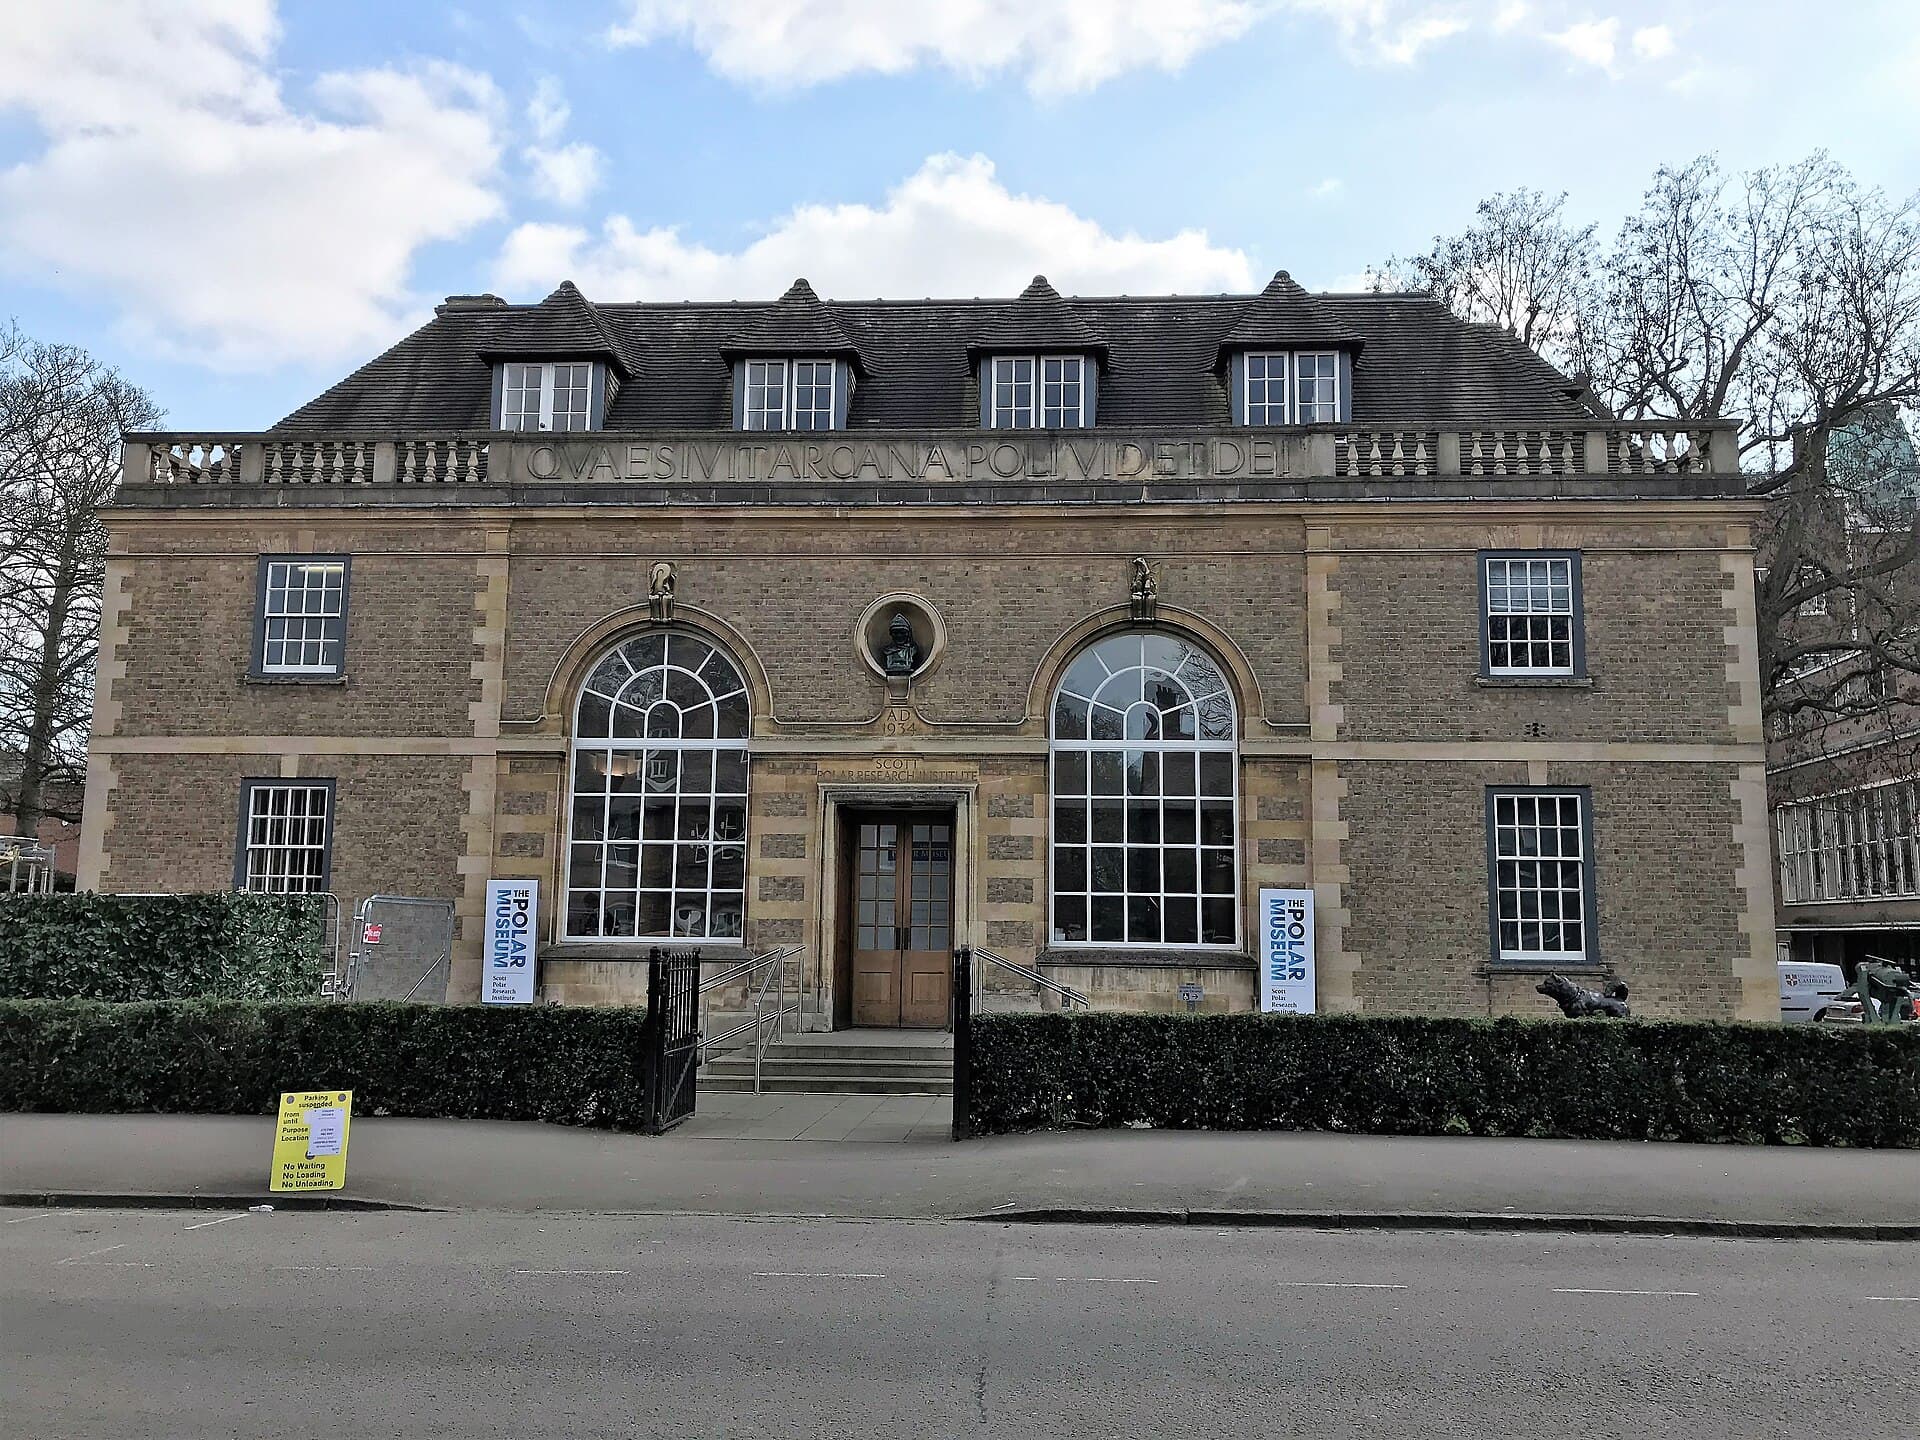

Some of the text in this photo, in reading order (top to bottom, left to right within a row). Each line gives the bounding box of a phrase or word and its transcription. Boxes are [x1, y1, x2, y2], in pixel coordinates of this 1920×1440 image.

[526, 439, 1290, 480] QVAESIVIT ARCANA POLI VIDET DEI
[883, 722, 917, 737] 1934
[875, 758, 917, 769] SCOTT
[817, 770, 978, 782] POLAR RESEARCH INSTITUTE
[513, 889, 530, 898] THE
[1287, 899, 1305, 908] THE
[494, 889, 512, 968] MUSEUM
[510, 898, 529, 968] POLAR
[1270, 898, 1287, 981] MUSEUM
[1287, 908, 1306, 981] POLAR
[298, 1101, 333, 1109] suspended
[297, 1162, 326, 1170] Waiting
[296, 1171, 326, 1179] Loading
[295, 1179, 334, 1188] Unloading
